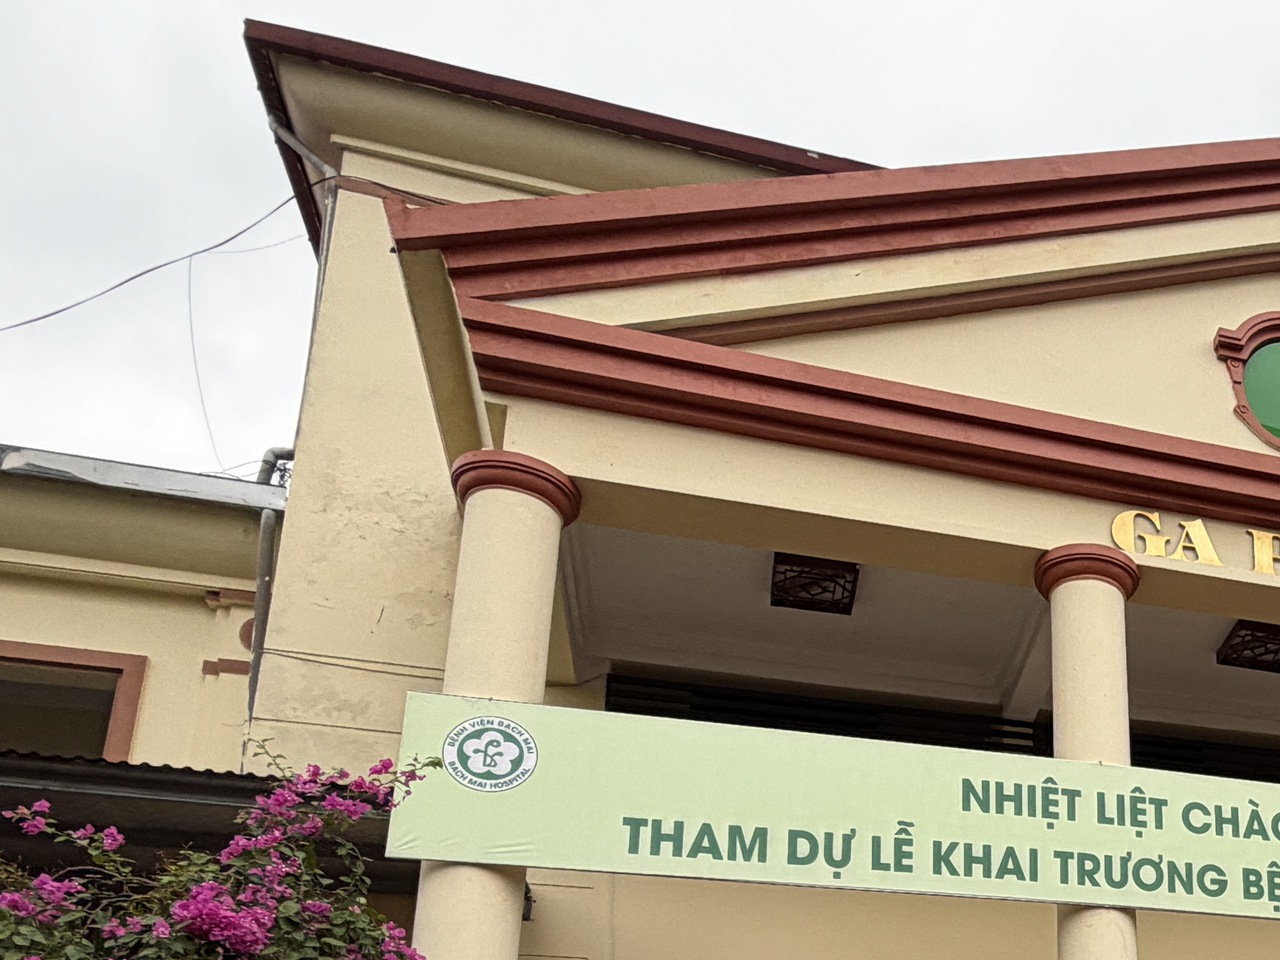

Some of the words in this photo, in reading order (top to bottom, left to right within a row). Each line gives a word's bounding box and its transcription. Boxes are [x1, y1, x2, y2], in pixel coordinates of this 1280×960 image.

[1111, 510, 1225, 567] GA
[521, 737, 535, 755] MAI
[467, 778, 487, 790] MAI
[489, 766, 532, 790] HOSPITAL
[962, 777, 1081, 830] NHIỆT
[1097, 786, 1168, 838] LIỆT
[622, 817, 768, 863] THAM
[788, 828, 858, 880] DỰ
[872, 820, 914, 873] LỄ
[933, 840, 1038, 883] KHAI
[1054, 850, 1228, 898] TRƯƠNG
